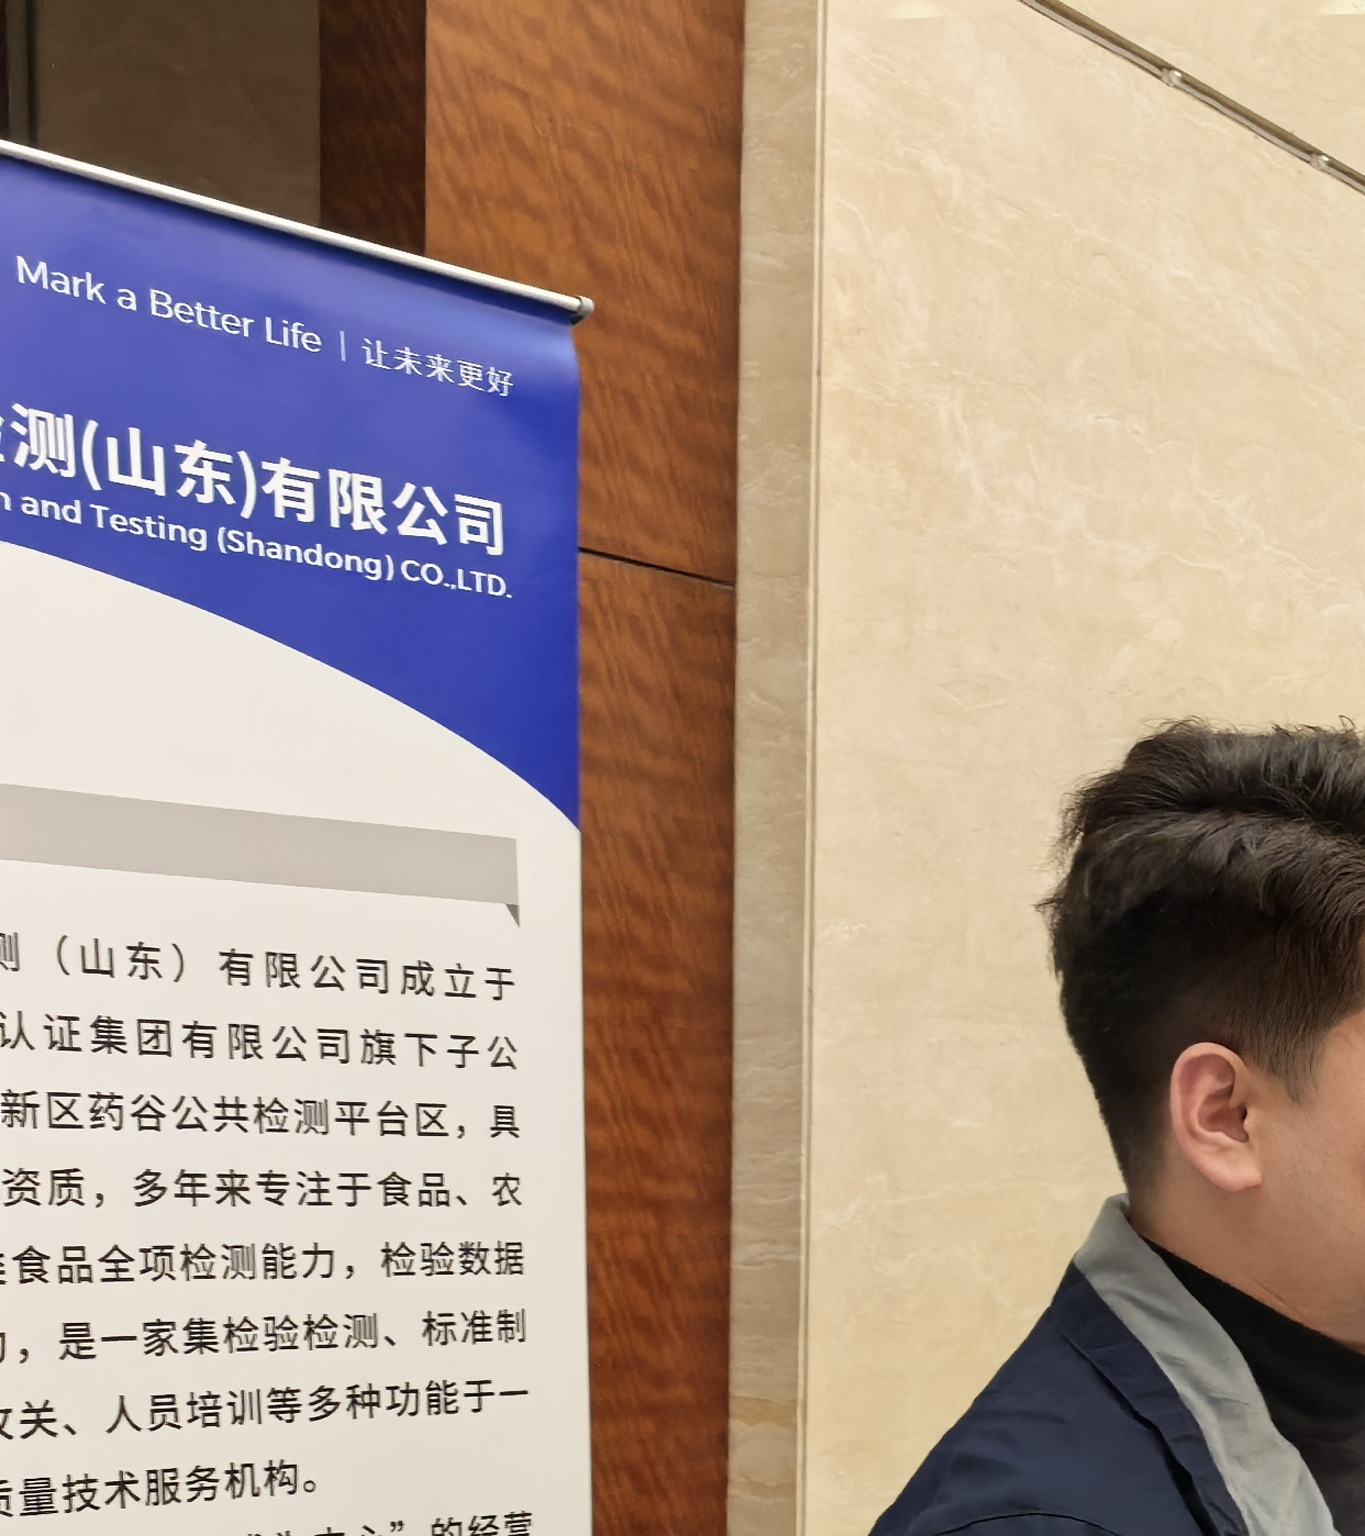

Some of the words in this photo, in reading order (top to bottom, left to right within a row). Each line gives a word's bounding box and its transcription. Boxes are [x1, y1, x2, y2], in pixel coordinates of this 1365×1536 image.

[16, 255, 107, 305] Mark
[117, 288, 137, 311] a
[150, 289, 254, 337] Better
[265, 316, 322, 353] Life
[362, 338, 514, 397] 让未来更好
[0, 403, 505, 556] 测(山东)有限公司
[21, 496, 82, 525] and
[89, 503, 208, 552] Testing
[217, 526, 394, 581] (Shandong)
[401, 559, 513, 599] CO.,LTD.
[0, 1241, 525, 1286] 食品全项检测能力，检验数据
